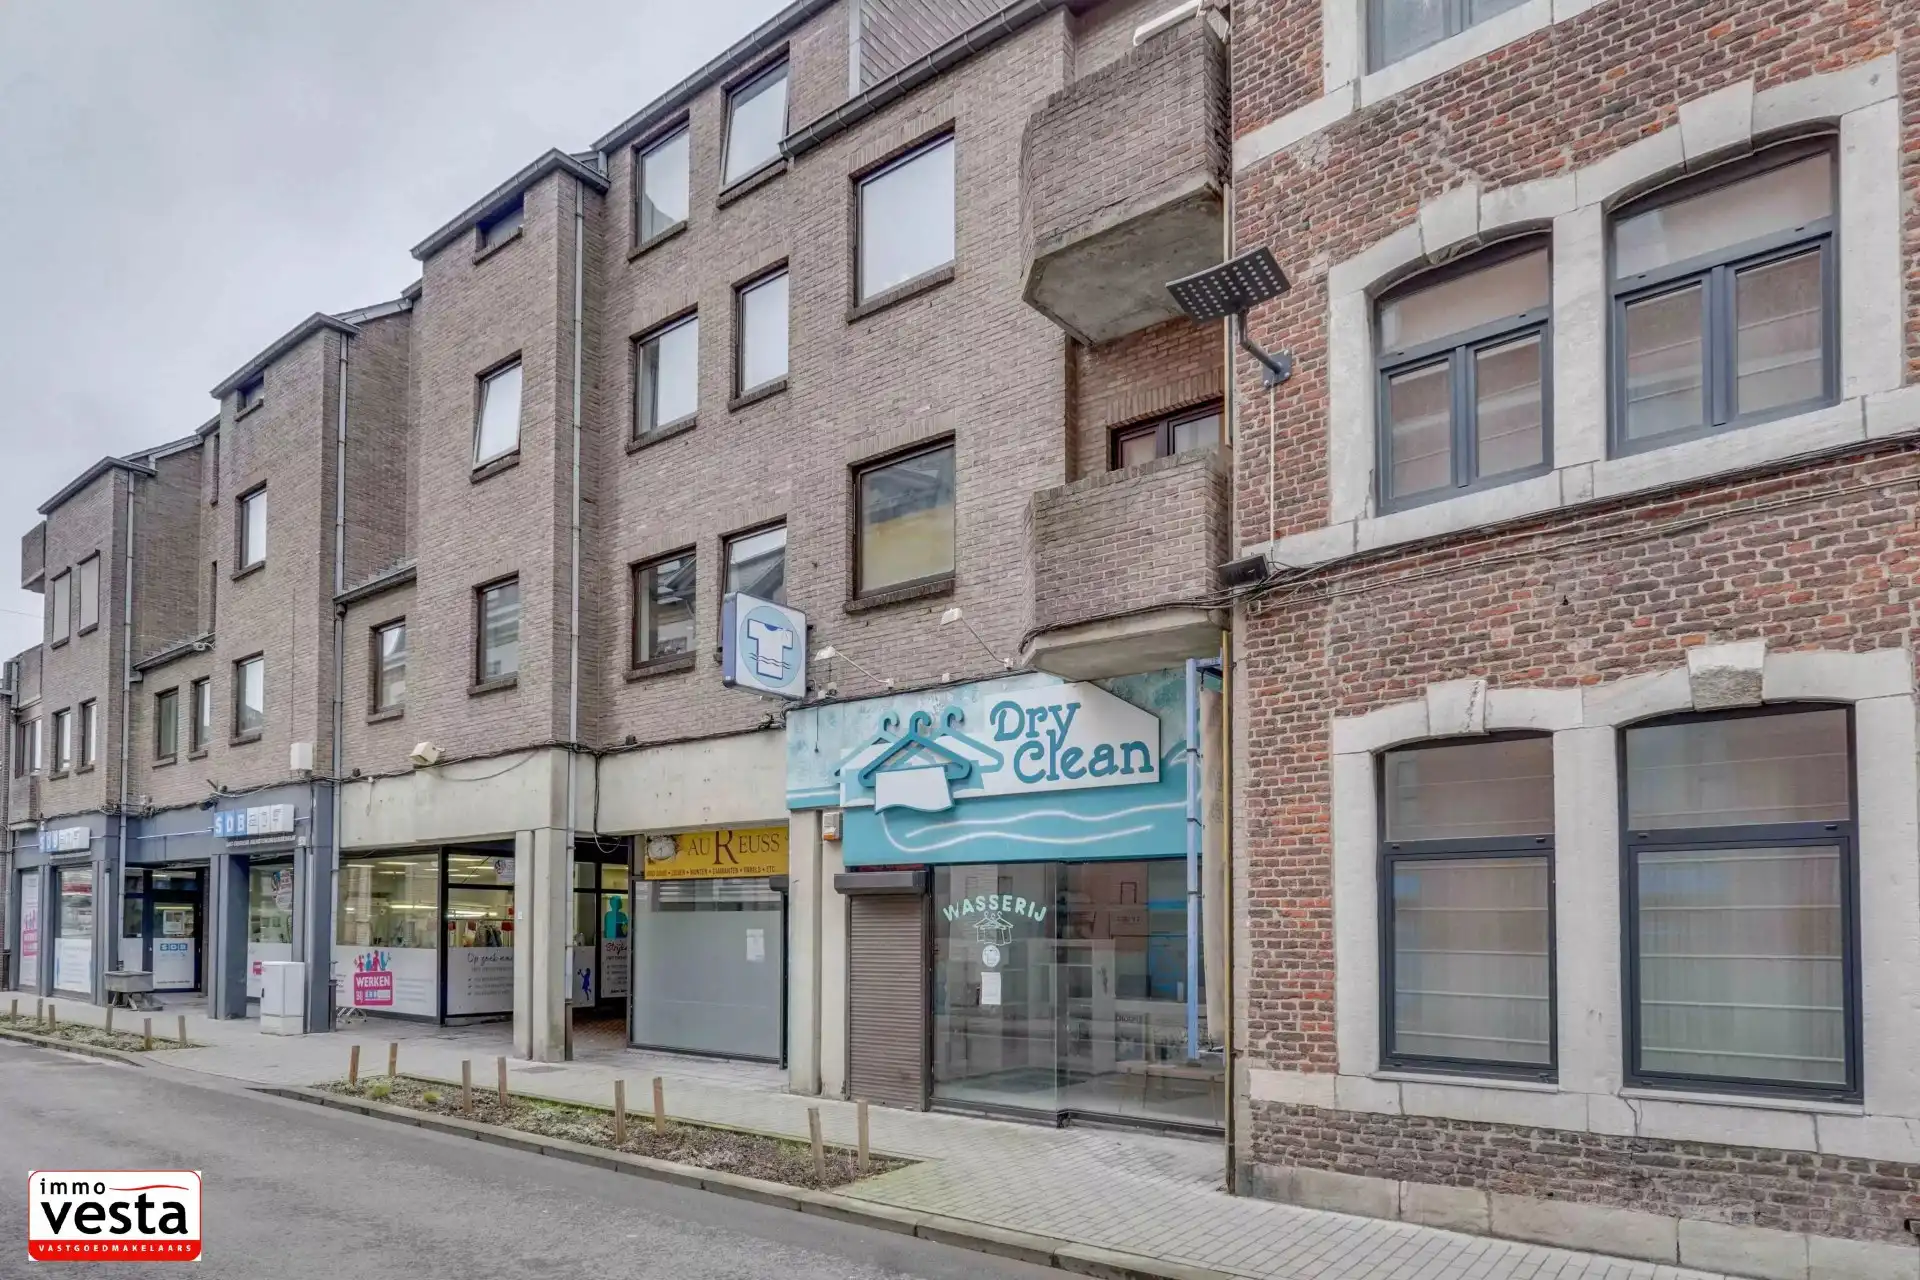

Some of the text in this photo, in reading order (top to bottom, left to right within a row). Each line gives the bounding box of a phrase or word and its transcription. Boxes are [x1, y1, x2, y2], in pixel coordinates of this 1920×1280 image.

[990, 700, 1081, 748] Dry
[1014, 729, 1154, 784] Clean
[942, 894, 1047, 922] WASSERIJ
[355, 975, 391, 988] WERKEN
